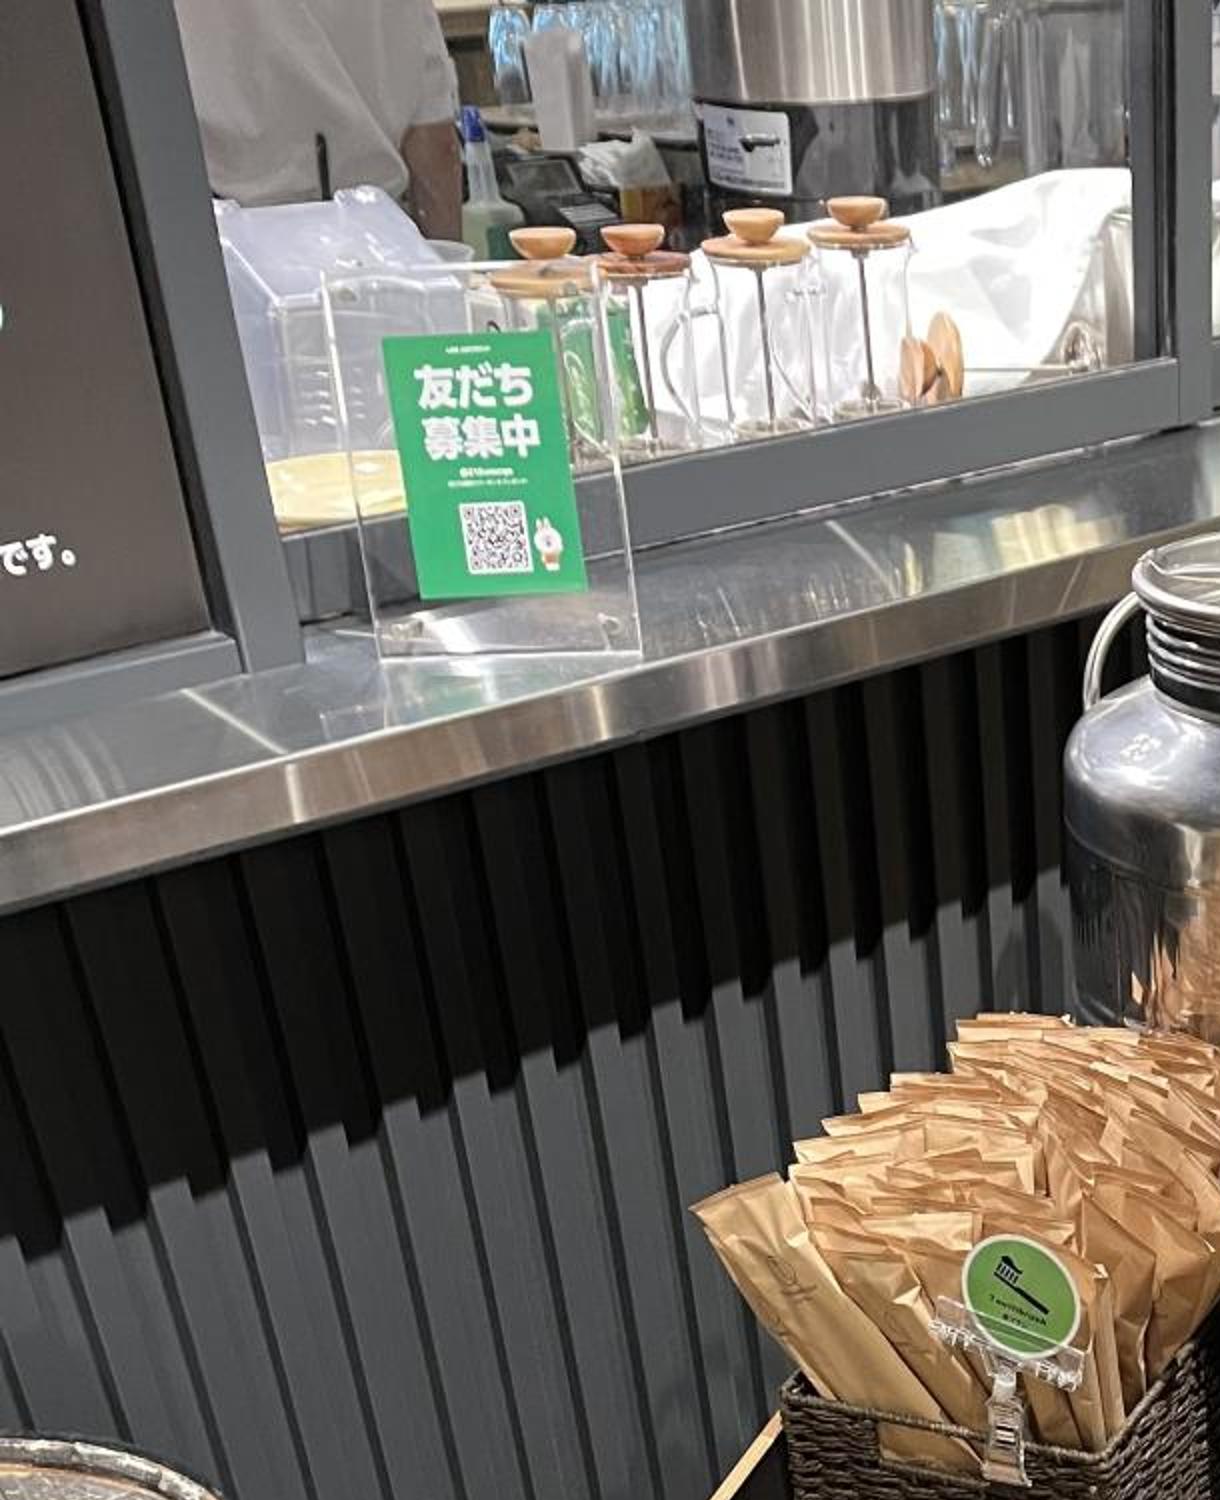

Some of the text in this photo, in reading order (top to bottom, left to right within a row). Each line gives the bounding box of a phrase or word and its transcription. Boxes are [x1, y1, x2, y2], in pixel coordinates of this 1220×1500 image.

[414, 361, 533, 410] 友だち
[421, 413, 541, 461] 募集中
[0, 533, 76, 576] です。
